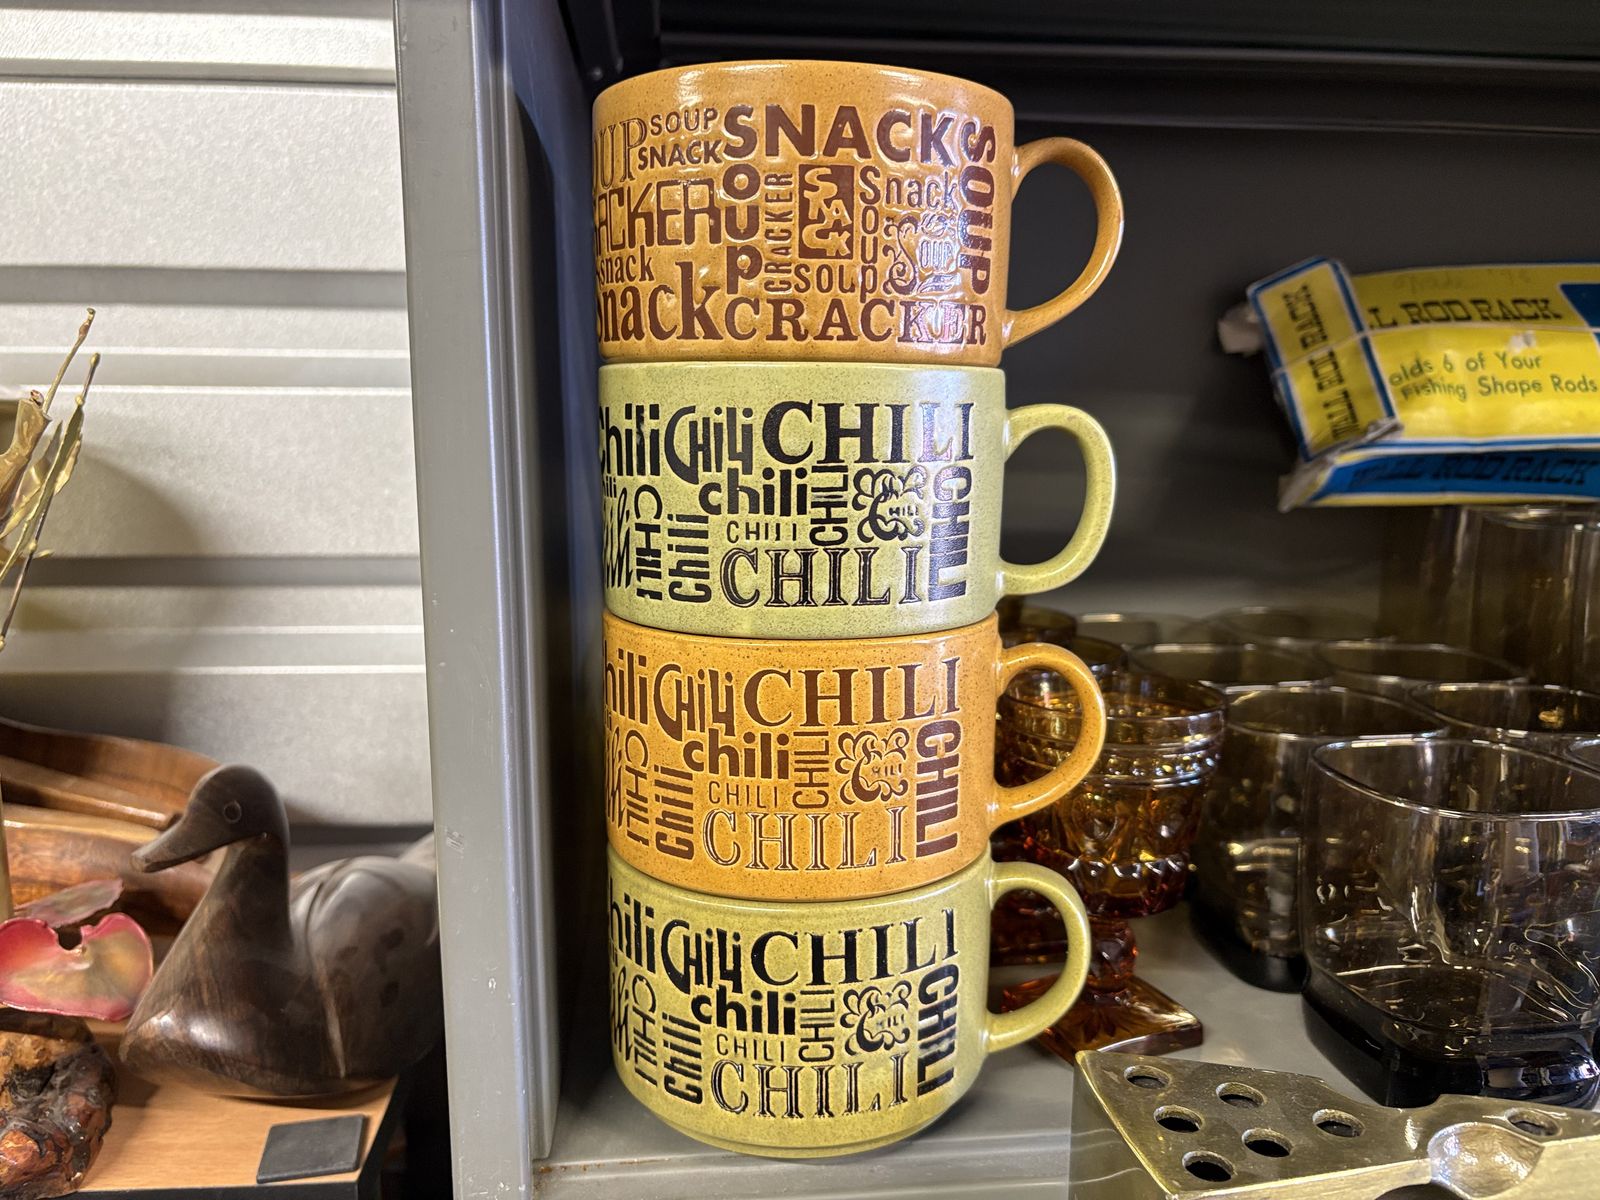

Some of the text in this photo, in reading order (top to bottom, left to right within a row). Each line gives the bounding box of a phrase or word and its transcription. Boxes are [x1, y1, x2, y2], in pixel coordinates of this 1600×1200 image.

[593, 117, 647, 189] UP
[638, 139, 722, 170] SNACK
[651, 108, 718, 136] SOUP
[723, 104, 955, 168] SNACK
[594, 178, 722, 254] ACKER
[764, 172, 793, 293] CRACKER
[961, 121, 996, 295] SOUP
[725, 297, 987, 346] CRACKER
[1402, 299, 1472, 325] ROD
[1470, 297, 1562, 323] RACK
[1443, 353, 1455, 373] 6
[1465, 351, 1486, 373] of
[1495, 351, 1543, 371] Your
[1477, 374, 1543, 397] Shape
[1550, 373, 1598, 394] Rods
[762, 400, 975, 465] CHILI
[698, 467, 809, 517] chili
[809, 465, 848, 547] CHILI
[928, 466, 972, 602] CHILI
[720, 547, 923, 608] CHILI
[743, 657, 961, 728] CHILI
[683, 728, 790, 780] chili
[792, 731, 830, 809] CHILI
[625, 729, 650, 847] CHILI
[708, 781, 778, 809] CHILI
[916, 719, 962, 858] CHILI
[703, 806, 907, 872] CHILI
[751, 907, 959, 986] CHILI
[632, 974, 659, 1087] CHILI
[691, 984, 796, 1036] chili
[798, 989, 834, 1063] CHILI
[917, 964, 959, 1097] CHILI
[716, 1034, 785, 1063] CHILI
[711, 1055, 910, 1119] CHILI
